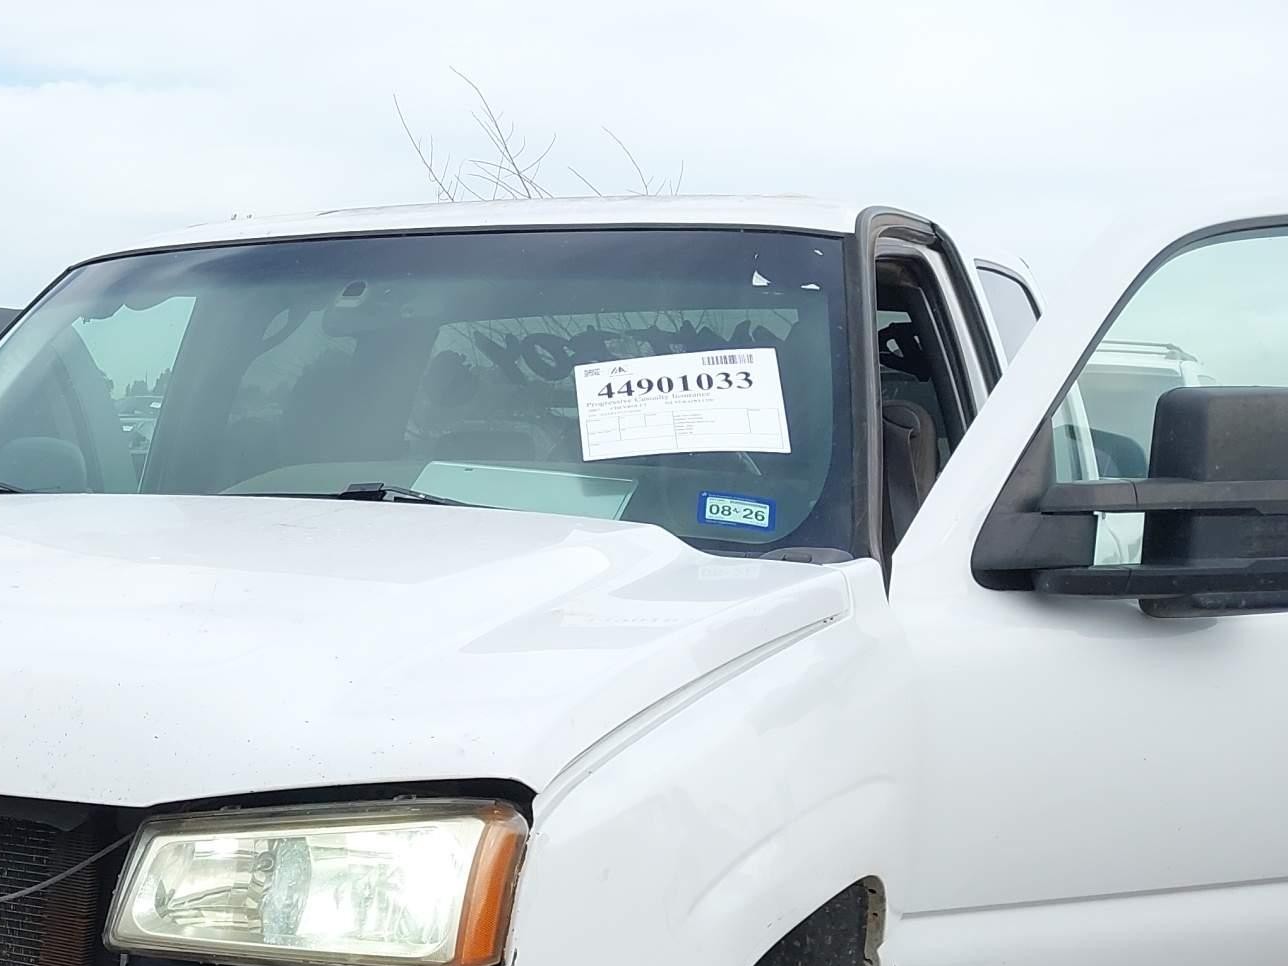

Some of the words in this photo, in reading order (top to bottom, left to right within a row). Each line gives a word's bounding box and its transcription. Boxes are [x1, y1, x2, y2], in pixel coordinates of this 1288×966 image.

[597, 371, 753, 399] 44901033
[709, 503, 732, 517] 08
[742, 507, 766, 522] 26
